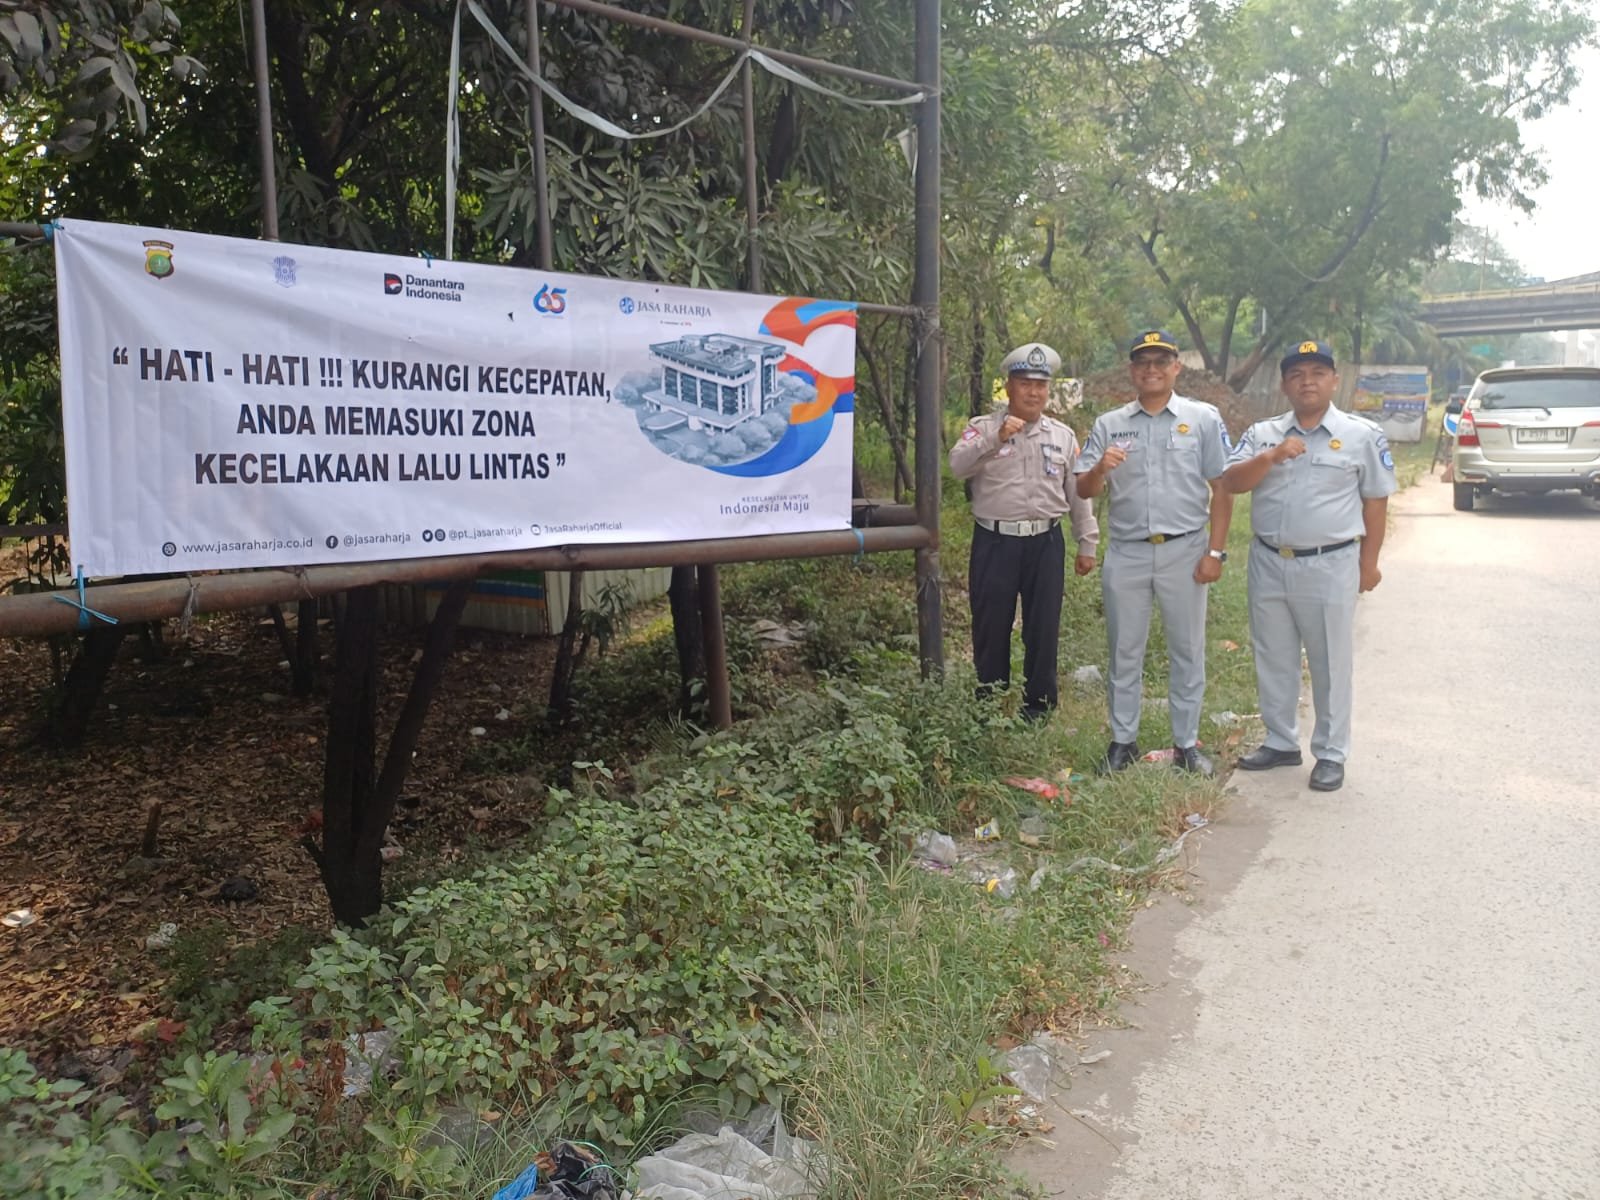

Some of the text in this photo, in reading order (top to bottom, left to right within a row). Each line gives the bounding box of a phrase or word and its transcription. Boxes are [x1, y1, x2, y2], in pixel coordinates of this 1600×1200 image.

[405, 274, 465, 291] Danantara
[405, 287, 462, 302] Indonesia
[533, 282, 567, 314] 65
[637, 300, 712, 318] JASA RAHARJA
[139, 347, 215, 383] HATI
[242, 353, 310, 387] HATI
[319, 357, 343, 388] !!!
[352, 359, 469, 393] KURANGI
[478, 366, 612, 404] KECEPATAN,
[236, 403, 536, 437] ANDA MEMASUKI ZONA
[1110, 430, 1139, 440] WAHYU
[195, 452, 389, 485] KECELAKAAN
[398, 453, 461, 482] LALU
[469, 452, 550, 480] LINTAS
[719, 500, 809, 514] Indonesia Maju
[343, 532, 412, 547] @jasaraharja
[448, 526, 523, 541] @pt_jasaraharja
[182, 537, 313, 555] www.jasaraharja.co.id
